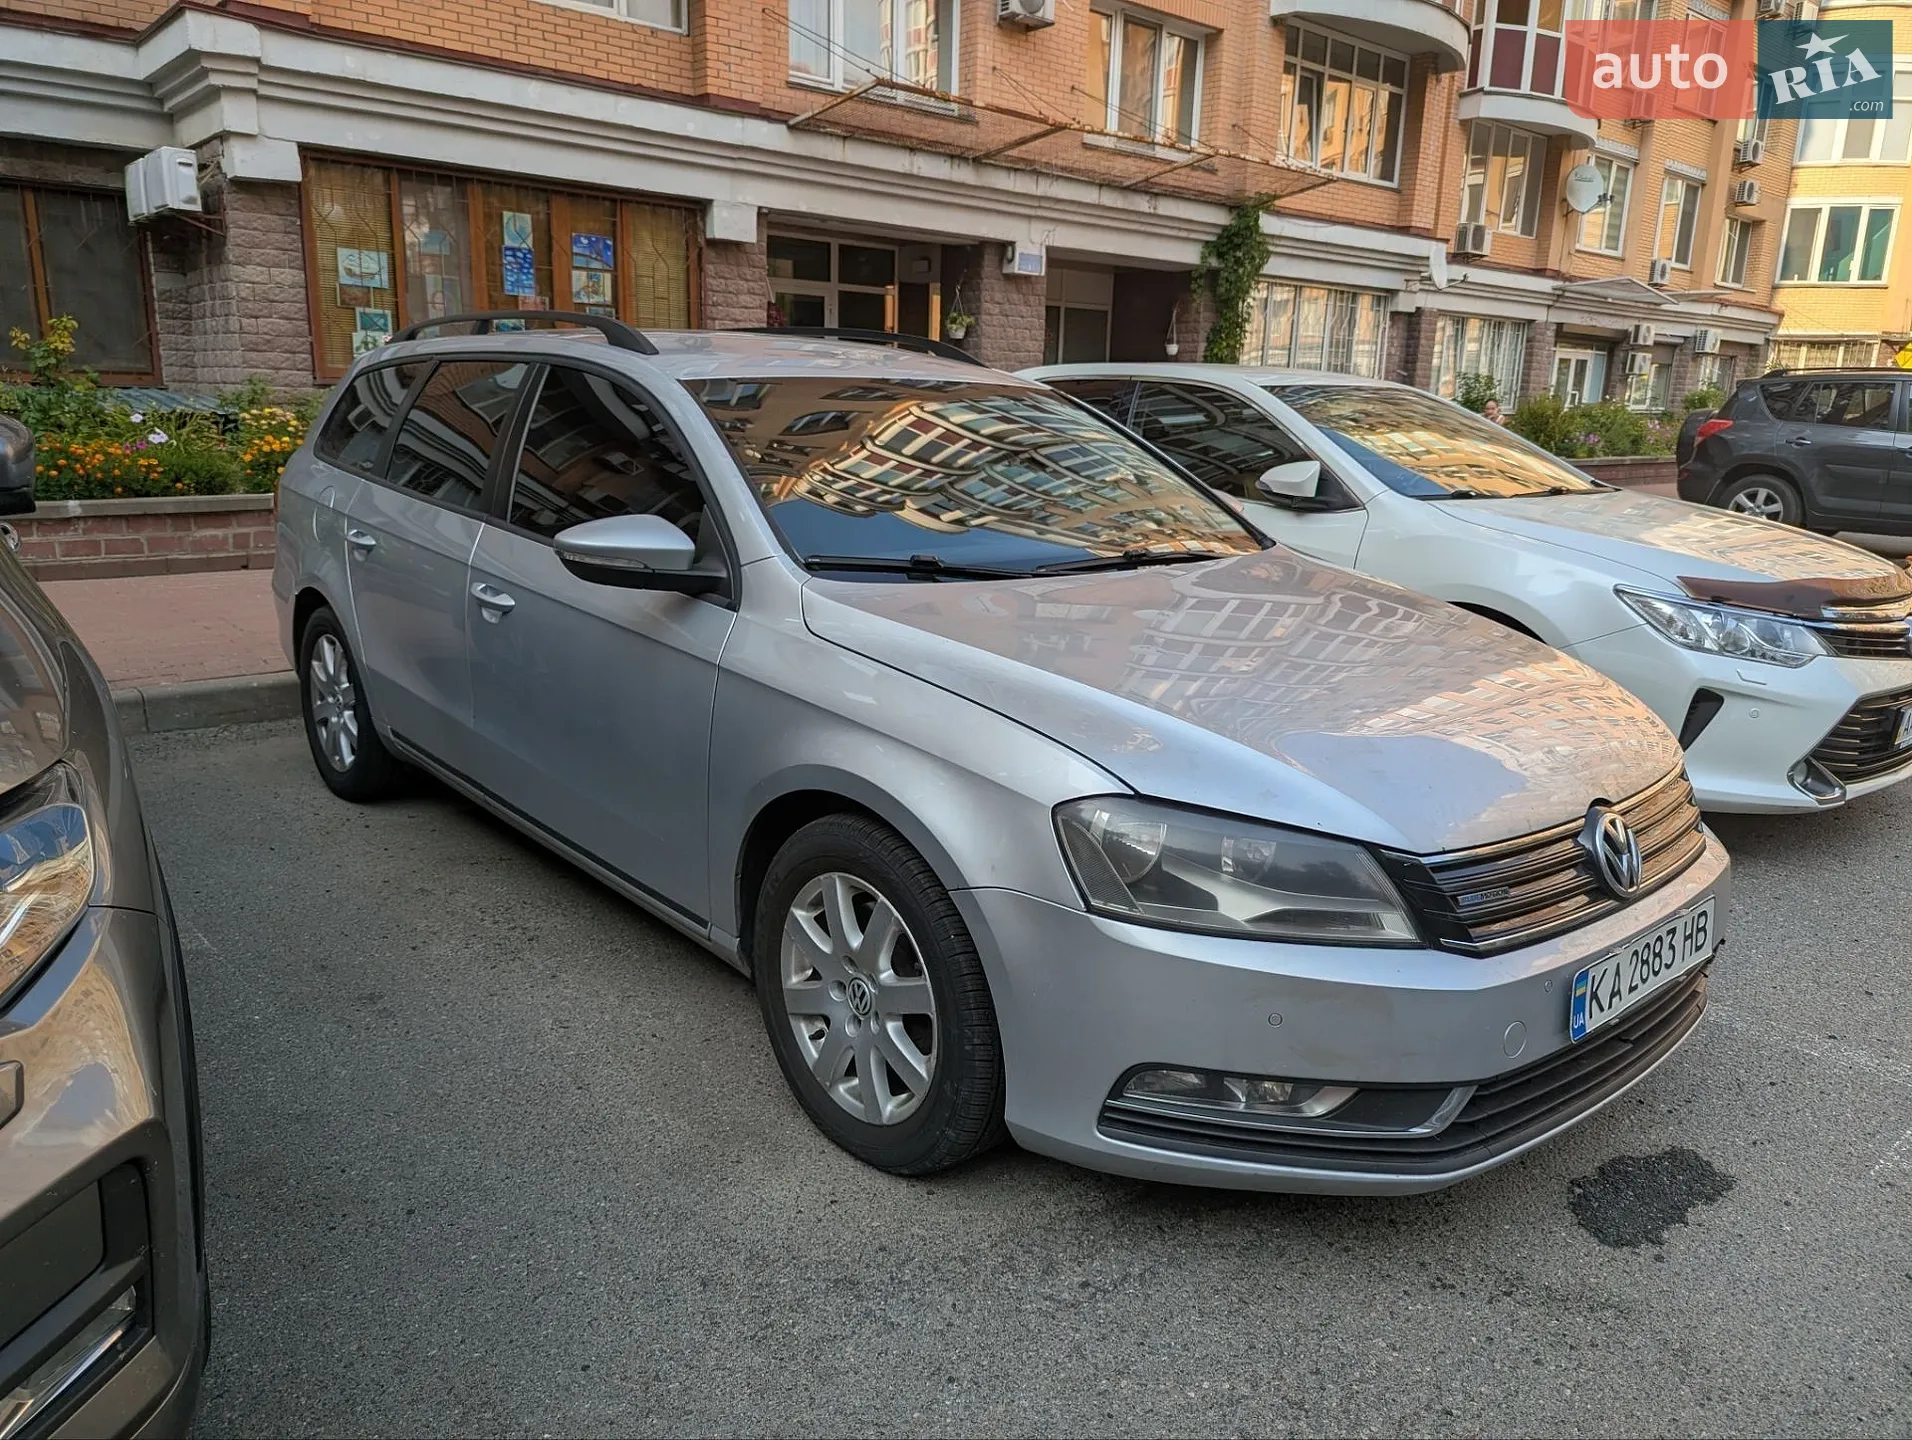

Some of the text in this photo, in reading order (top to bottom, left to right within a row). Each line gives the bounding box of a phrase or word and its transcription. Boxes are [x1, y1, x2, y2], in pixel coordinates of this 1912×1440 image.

[1589, 910, 1709, 1019] KA 2883 HB
[1573, 1012, 1585, 1029] UA
